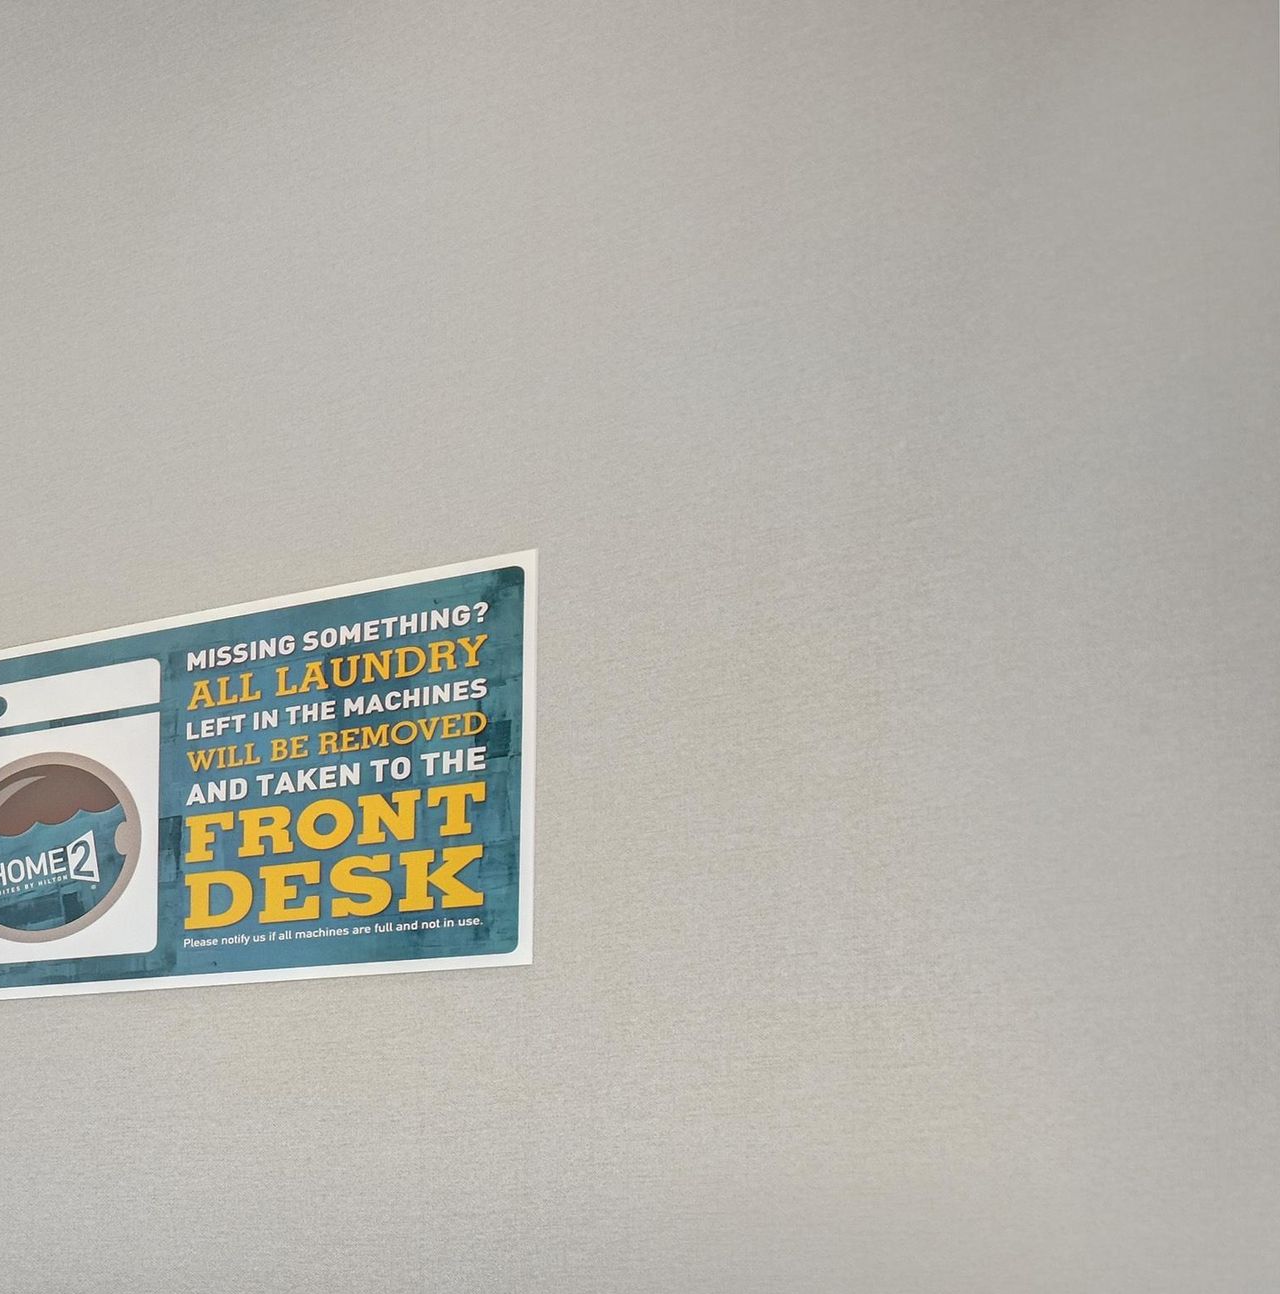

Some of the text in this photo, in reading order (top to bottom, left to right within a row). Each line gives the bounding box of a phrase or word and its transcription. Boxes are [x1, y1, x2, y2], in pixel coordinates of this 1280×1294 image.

[187, 601, 489, 671] MISSING SOMETHING?
[187, 634, 488, 710] ALL LAUNDRY
[186, 678, 487, 740] LEFT IN THE MACHINES
[187, 711, 487, 772] WILL BE REMOVED
[186, 746, 486, 806] AND TAKEN TO THE
[185, 781, 486, 863] FRONT
[24, 883, 34, 891] BY
[38, 874, 68, 888] HILTON
[184, 845, 484, 930] DESK
[183, 917, 484, 948] Please notify us if all machines are full and not in use.
